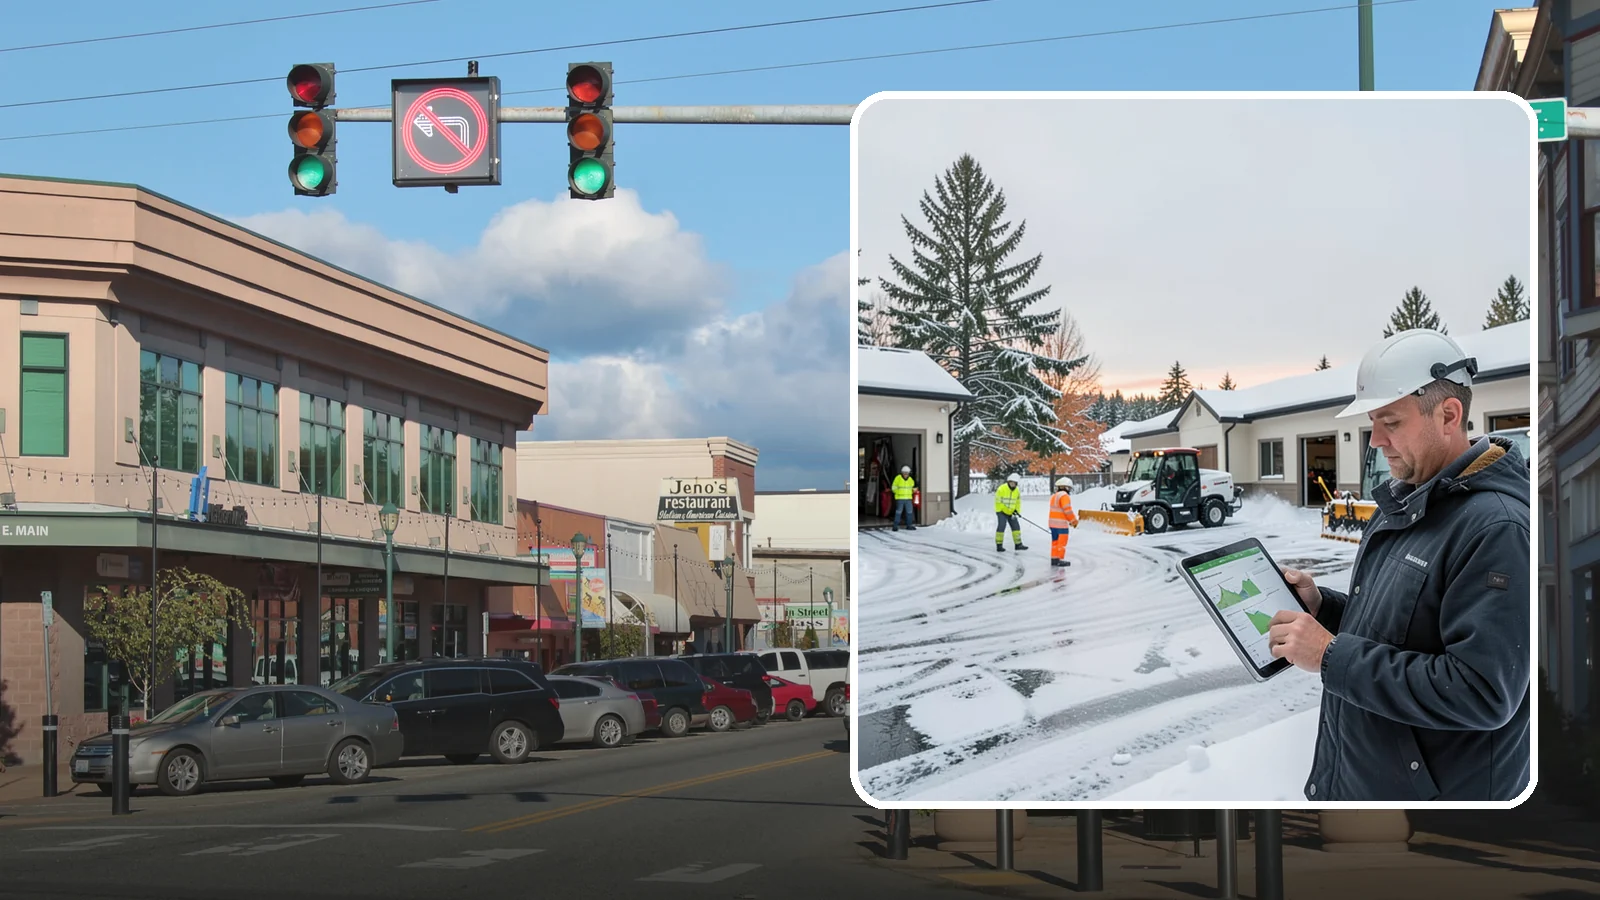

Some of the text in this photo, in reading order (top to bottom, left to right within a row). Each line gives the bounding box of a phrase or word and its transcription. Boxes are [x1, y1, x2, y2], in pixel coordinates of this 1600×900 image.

[670, 480, 727, 494] Jeno's
[665, 496, 731, 509] restaurant
[659, 510, 681, 519] Italian
[686, 509, 714, 519] American
[715, 509, 737, 519] Cuisine
[2, 525, 49, 536] E. MAIN
[797, 607, 828, 617] Street
